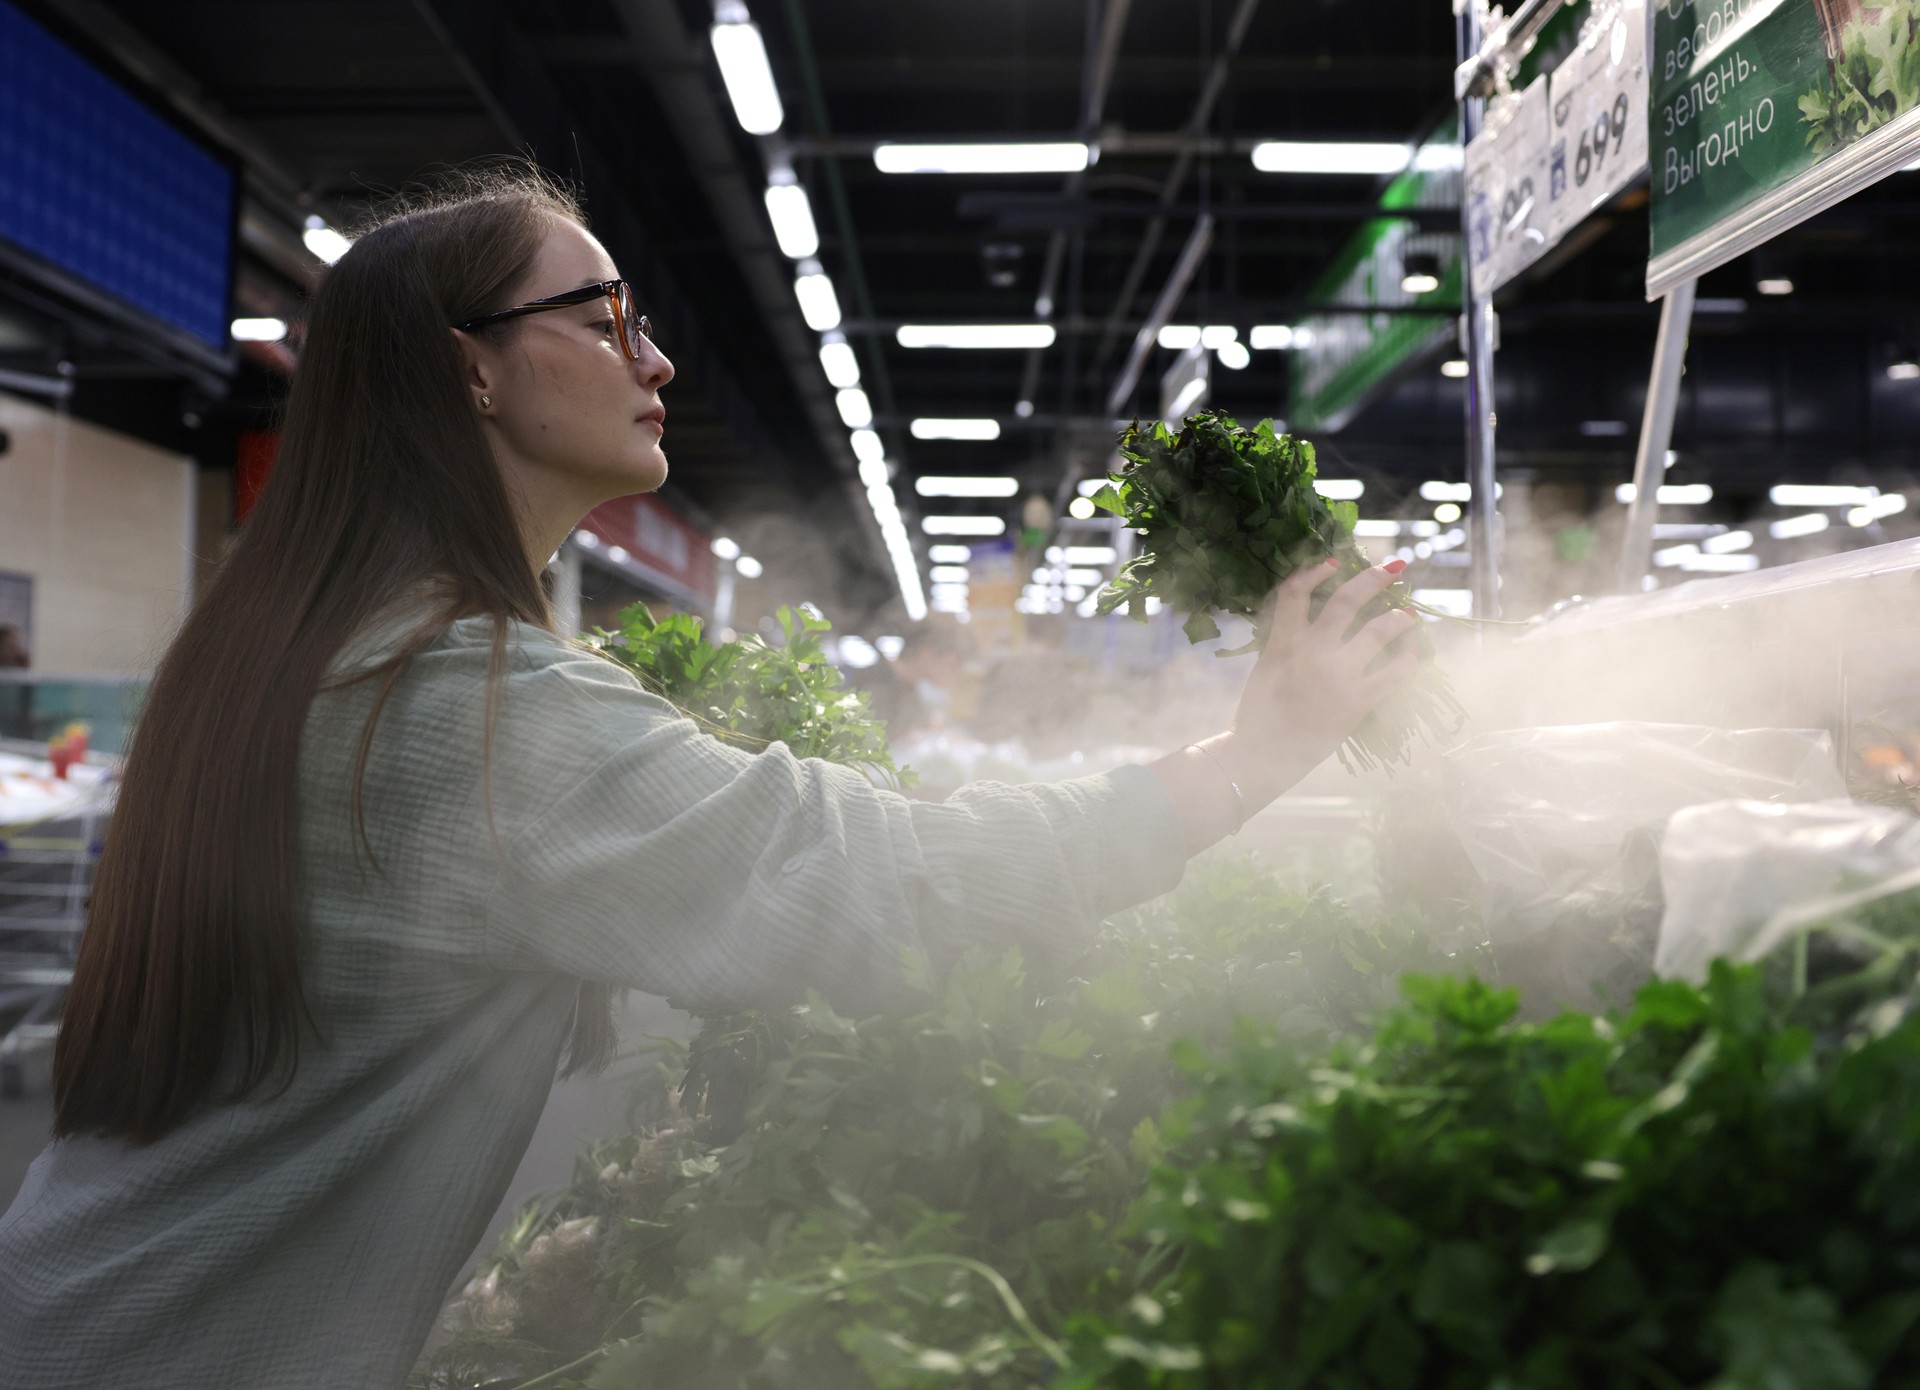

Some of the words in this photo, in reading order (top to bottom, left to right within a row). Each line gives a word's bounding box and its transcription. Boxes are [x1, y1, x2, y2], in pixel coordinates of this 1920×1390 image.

[1575, 92, 1628, 188] 699
[1663, 51, 1758, 137] зелень.
[1664, 97, 1775, 195] Выгодно
